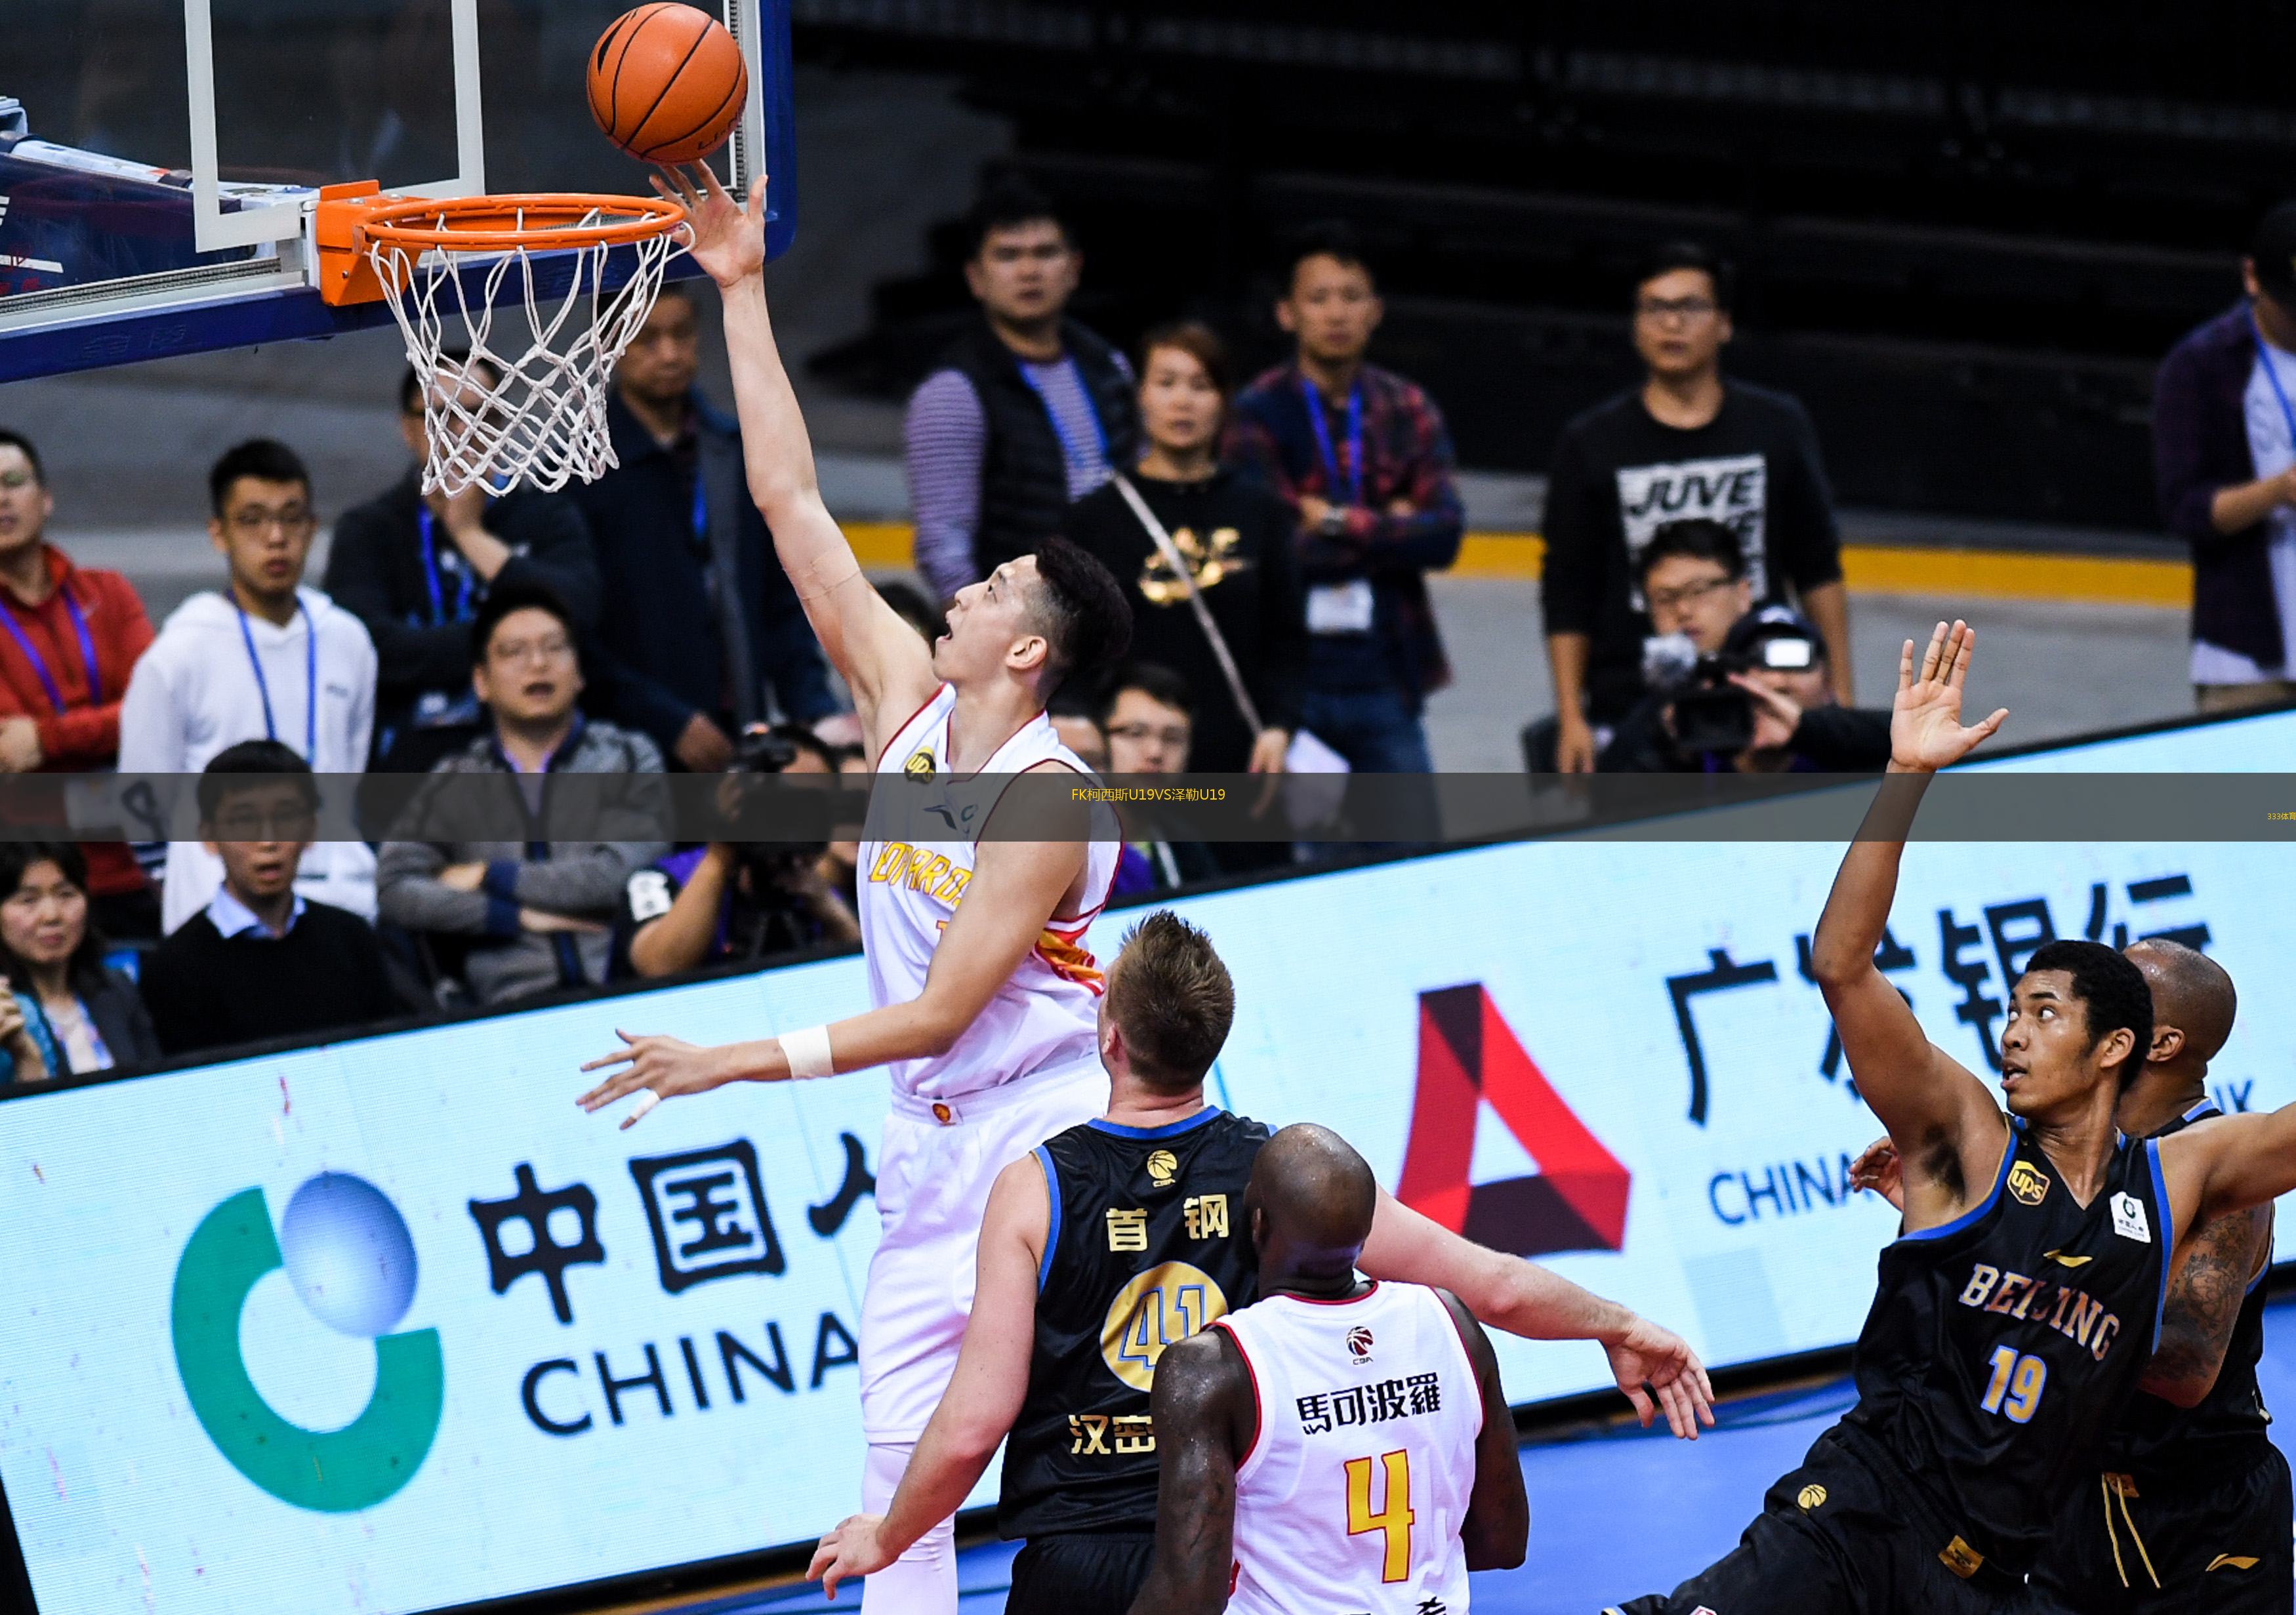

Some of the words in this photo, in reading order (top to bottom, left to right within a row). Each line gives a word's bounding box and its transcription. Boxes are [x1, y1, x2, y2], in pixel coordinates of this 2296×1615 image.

[1626, 468, 1758, 516] JUVE
[2011, 1170, 2043, 1200] ups
[1117, 1284, 1204, 1370] 41
[521, 1311, 859, 1435] CHINA
[1296, 1372, 1441, 1435] 馬可波羅
[1981, 1345, 2047, 1424] 19
[1069, 1415, 1156, 1454] 汉密
[1344, 1448, 1415, 1584] 4
